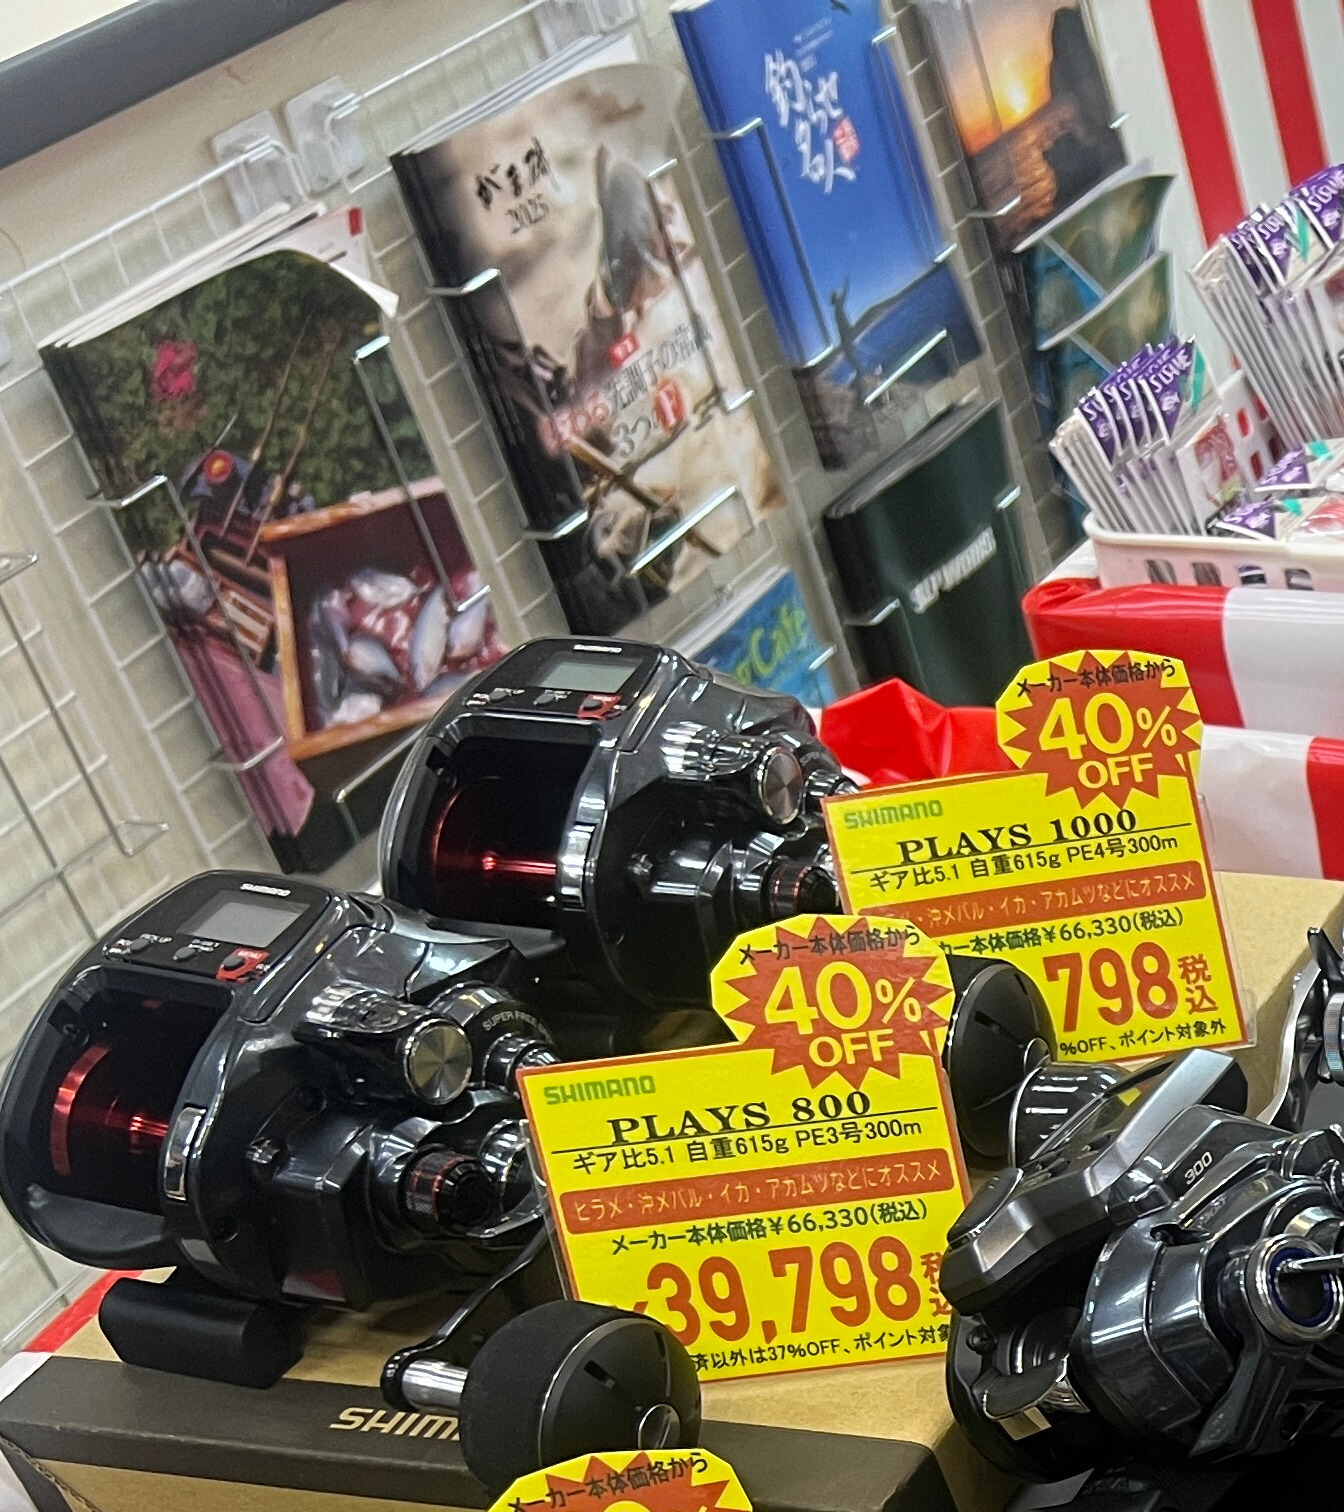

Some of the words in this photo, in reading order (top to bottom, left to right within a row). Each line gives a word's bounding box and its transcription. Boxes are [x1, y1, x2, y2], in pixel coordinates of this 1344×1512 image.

[1016, 659, 1175, 697] メーカー本体価格から
[1039, 693, 1177, 760] 40%
[1078, 755, 1153, 789] OFF
[844, 800, 943, 830] SHIMANO
[898, 823, 1032, 863] PLAYS
[1052, 808, 1137, 842] 1000
[869, 862, 960, 892] ギア比5.1
[971, 850, 1060, 878] 自重615g
[1068, 833, 1179, 862] PE4号300m
[739, 924, 920, 964] メーカー本体価格から
[764, 961, 922, 1035] 40%
[1177, 954, 1218, 1015] 税込
[483, 1011, 514, 1031] SUPER
[809, 1031, 894, 1067] OFF
[543, 1075, 655, 1105] SHIMANO
[607, 1101, 770, 1144] PLAYS
[792, 1091, 870, 1119] 800
[573, 1141, 675, 1174] ギア比5.1
[688, 1135, 789, 1162] 自重615g
[797, 1120, 922, 1150] PE3号300m
